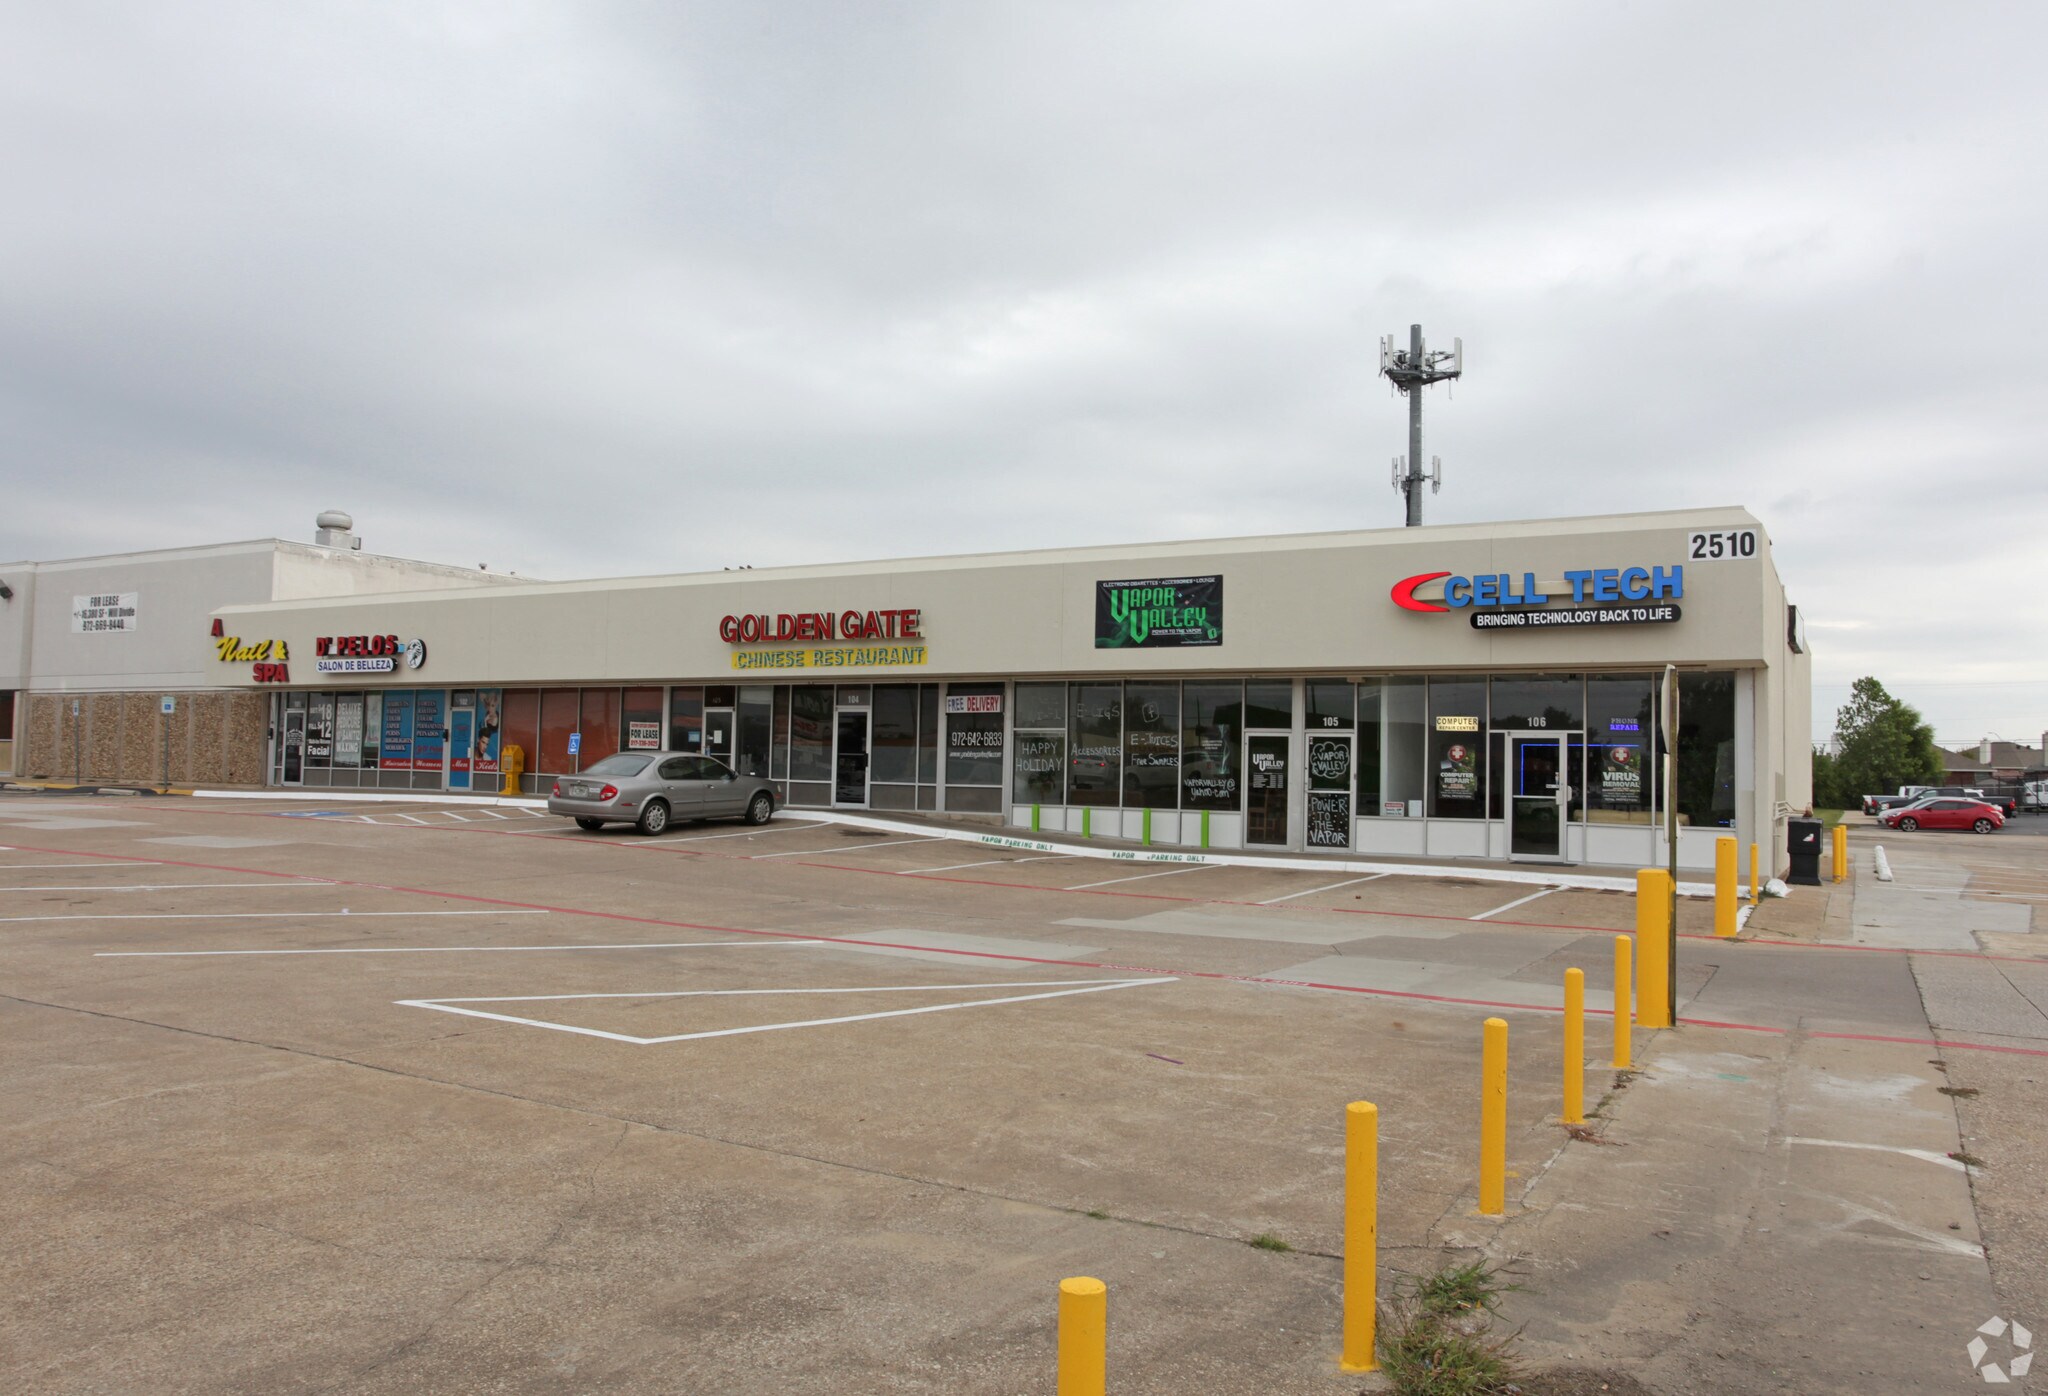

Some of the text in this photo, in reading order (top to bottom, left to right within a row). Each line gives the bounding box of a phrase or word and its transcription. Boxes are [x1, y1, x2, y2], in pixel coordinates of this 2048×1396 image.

[1692, 531, 1755, 559] 2510
[1443, 565, 1683, 607] CELL TECH
[90, 595, 120, 607] FOR LEASE
[1111, 587, 1176, 623] VAPOR
[1477, 607, 1672, 627] BRINGING TECHNOLOGY BACK TO LIFE
[211, 618, 224, 637] A
[720, 609, 921, 644] GOLDEN GATE
[1131, 607, 1207, 644] VALLEY
[216, 636, 289, 662] Nail &
[337, 635, 398, 656] PELOS
[737, 647, 925, 669] CHINESE RESTAURANT
[318, 659, 392, 671] SALON DE BELLEZA
[252, 662, 290, 683] SPA
[848, 695, 859, 704] 104
[948, 696, 1000, 712] FREE DELIVERY
[337, 702, 362, 716] DELUXE
[1322, 716, 1339, 727] 105
[1436, 717, 1478, 725] COMPUTER
[1527, 716, 1547, 728] 106
[631, 729, 658, 740] FOR LEASE
[952, 731, 1003, 746] 972-642-6833
[307, 745, 330, 756] Facial
[336, 741, 360, 753] WAXING
[1021, 742, 1059, 756] HAPPY
[1253, 753, 1275, 766] VAPOR
[1316, 750, 1346, 762] VAPOR
[415, 760, 443, 769] Women
[452, 759, 469, 768] Men
[475, 760, 499, 771] Kids
[1015, 757, 1064, 773] HOLIDAY
[1259, 760, 1285, 772] VALLEY
[1316, 760, 1346, 772] VALLEY
[1602, 771, 1640, 782] VIRUS
[1311, 797, 1348, 815] POWER
[1317, 811, 1331, 821] TO
[1313, 820, 1335, 831] THE
[982, 836, 1054, 851] VAPOR PARKING ONLY
[1309, 830, 1346, 845] VAPOR
[1112, 851, 1206, 863] VAPOR PARKING ONLY
